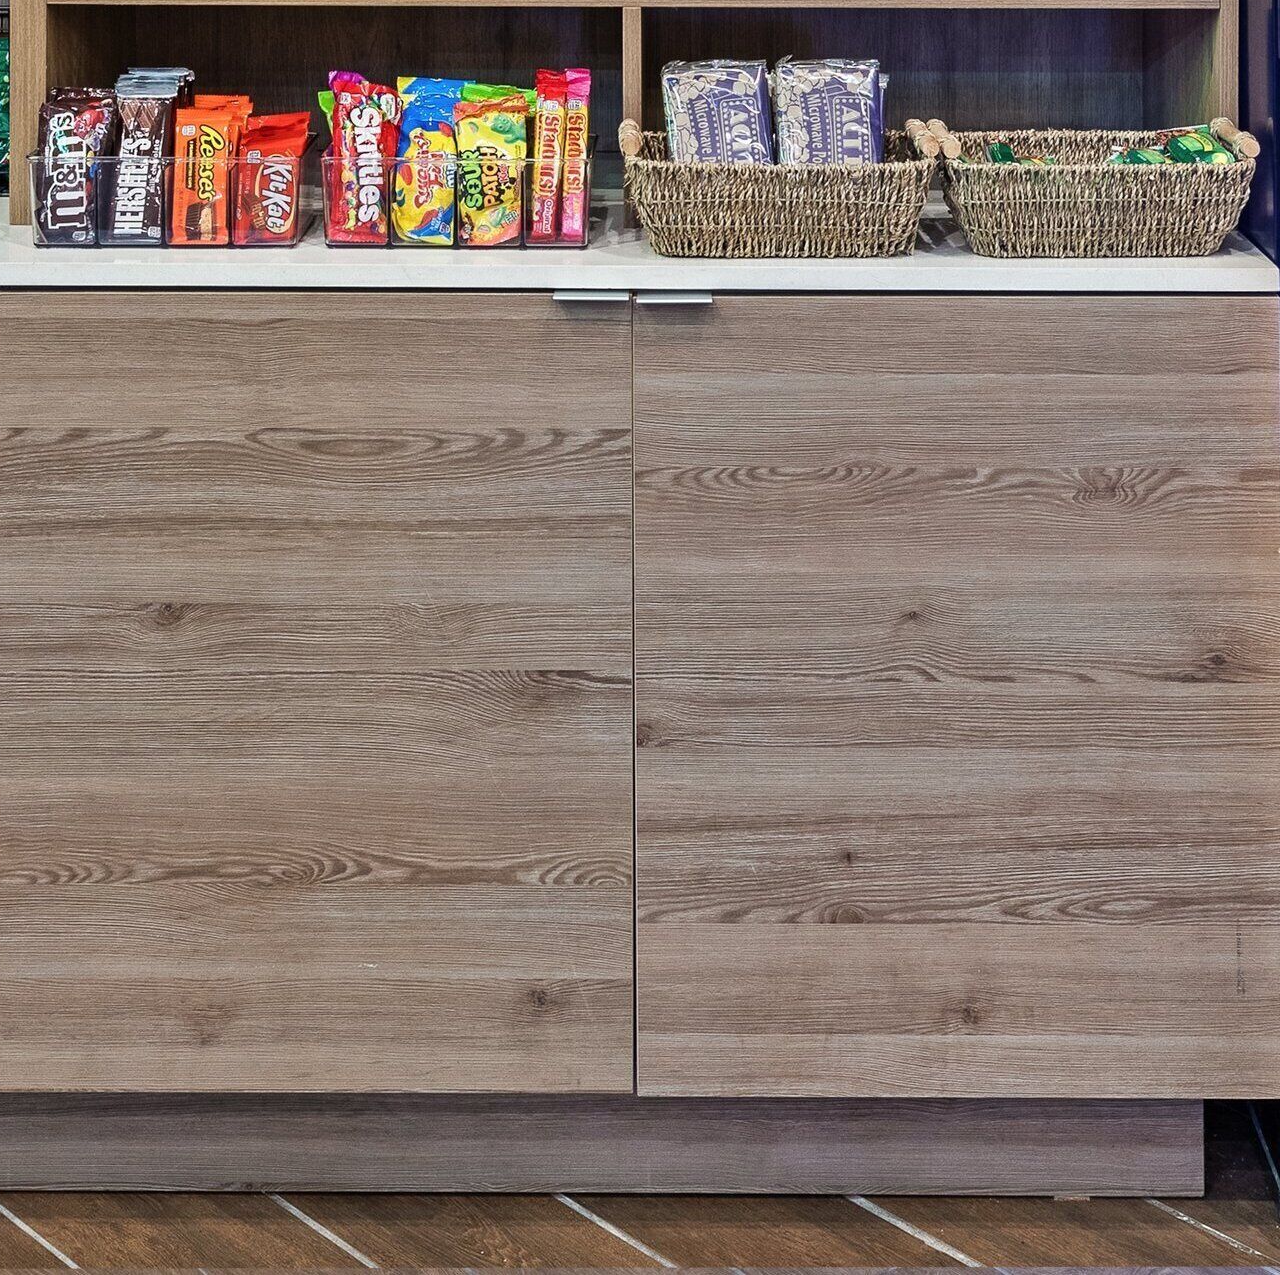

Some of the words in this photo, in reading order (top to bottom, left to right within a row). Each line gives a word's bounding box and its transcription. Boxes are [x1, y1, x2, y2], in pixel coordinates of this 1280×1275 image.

[693, 99, 713, 155] Microwave
[806, 93, 823, 150] Microwave
[198, 124, 225, 202] Reese's
[464, 150, 484, 210] SOUR
[478, 146, 498, 208] PATCH
[543, 200, 553, 234] Original
